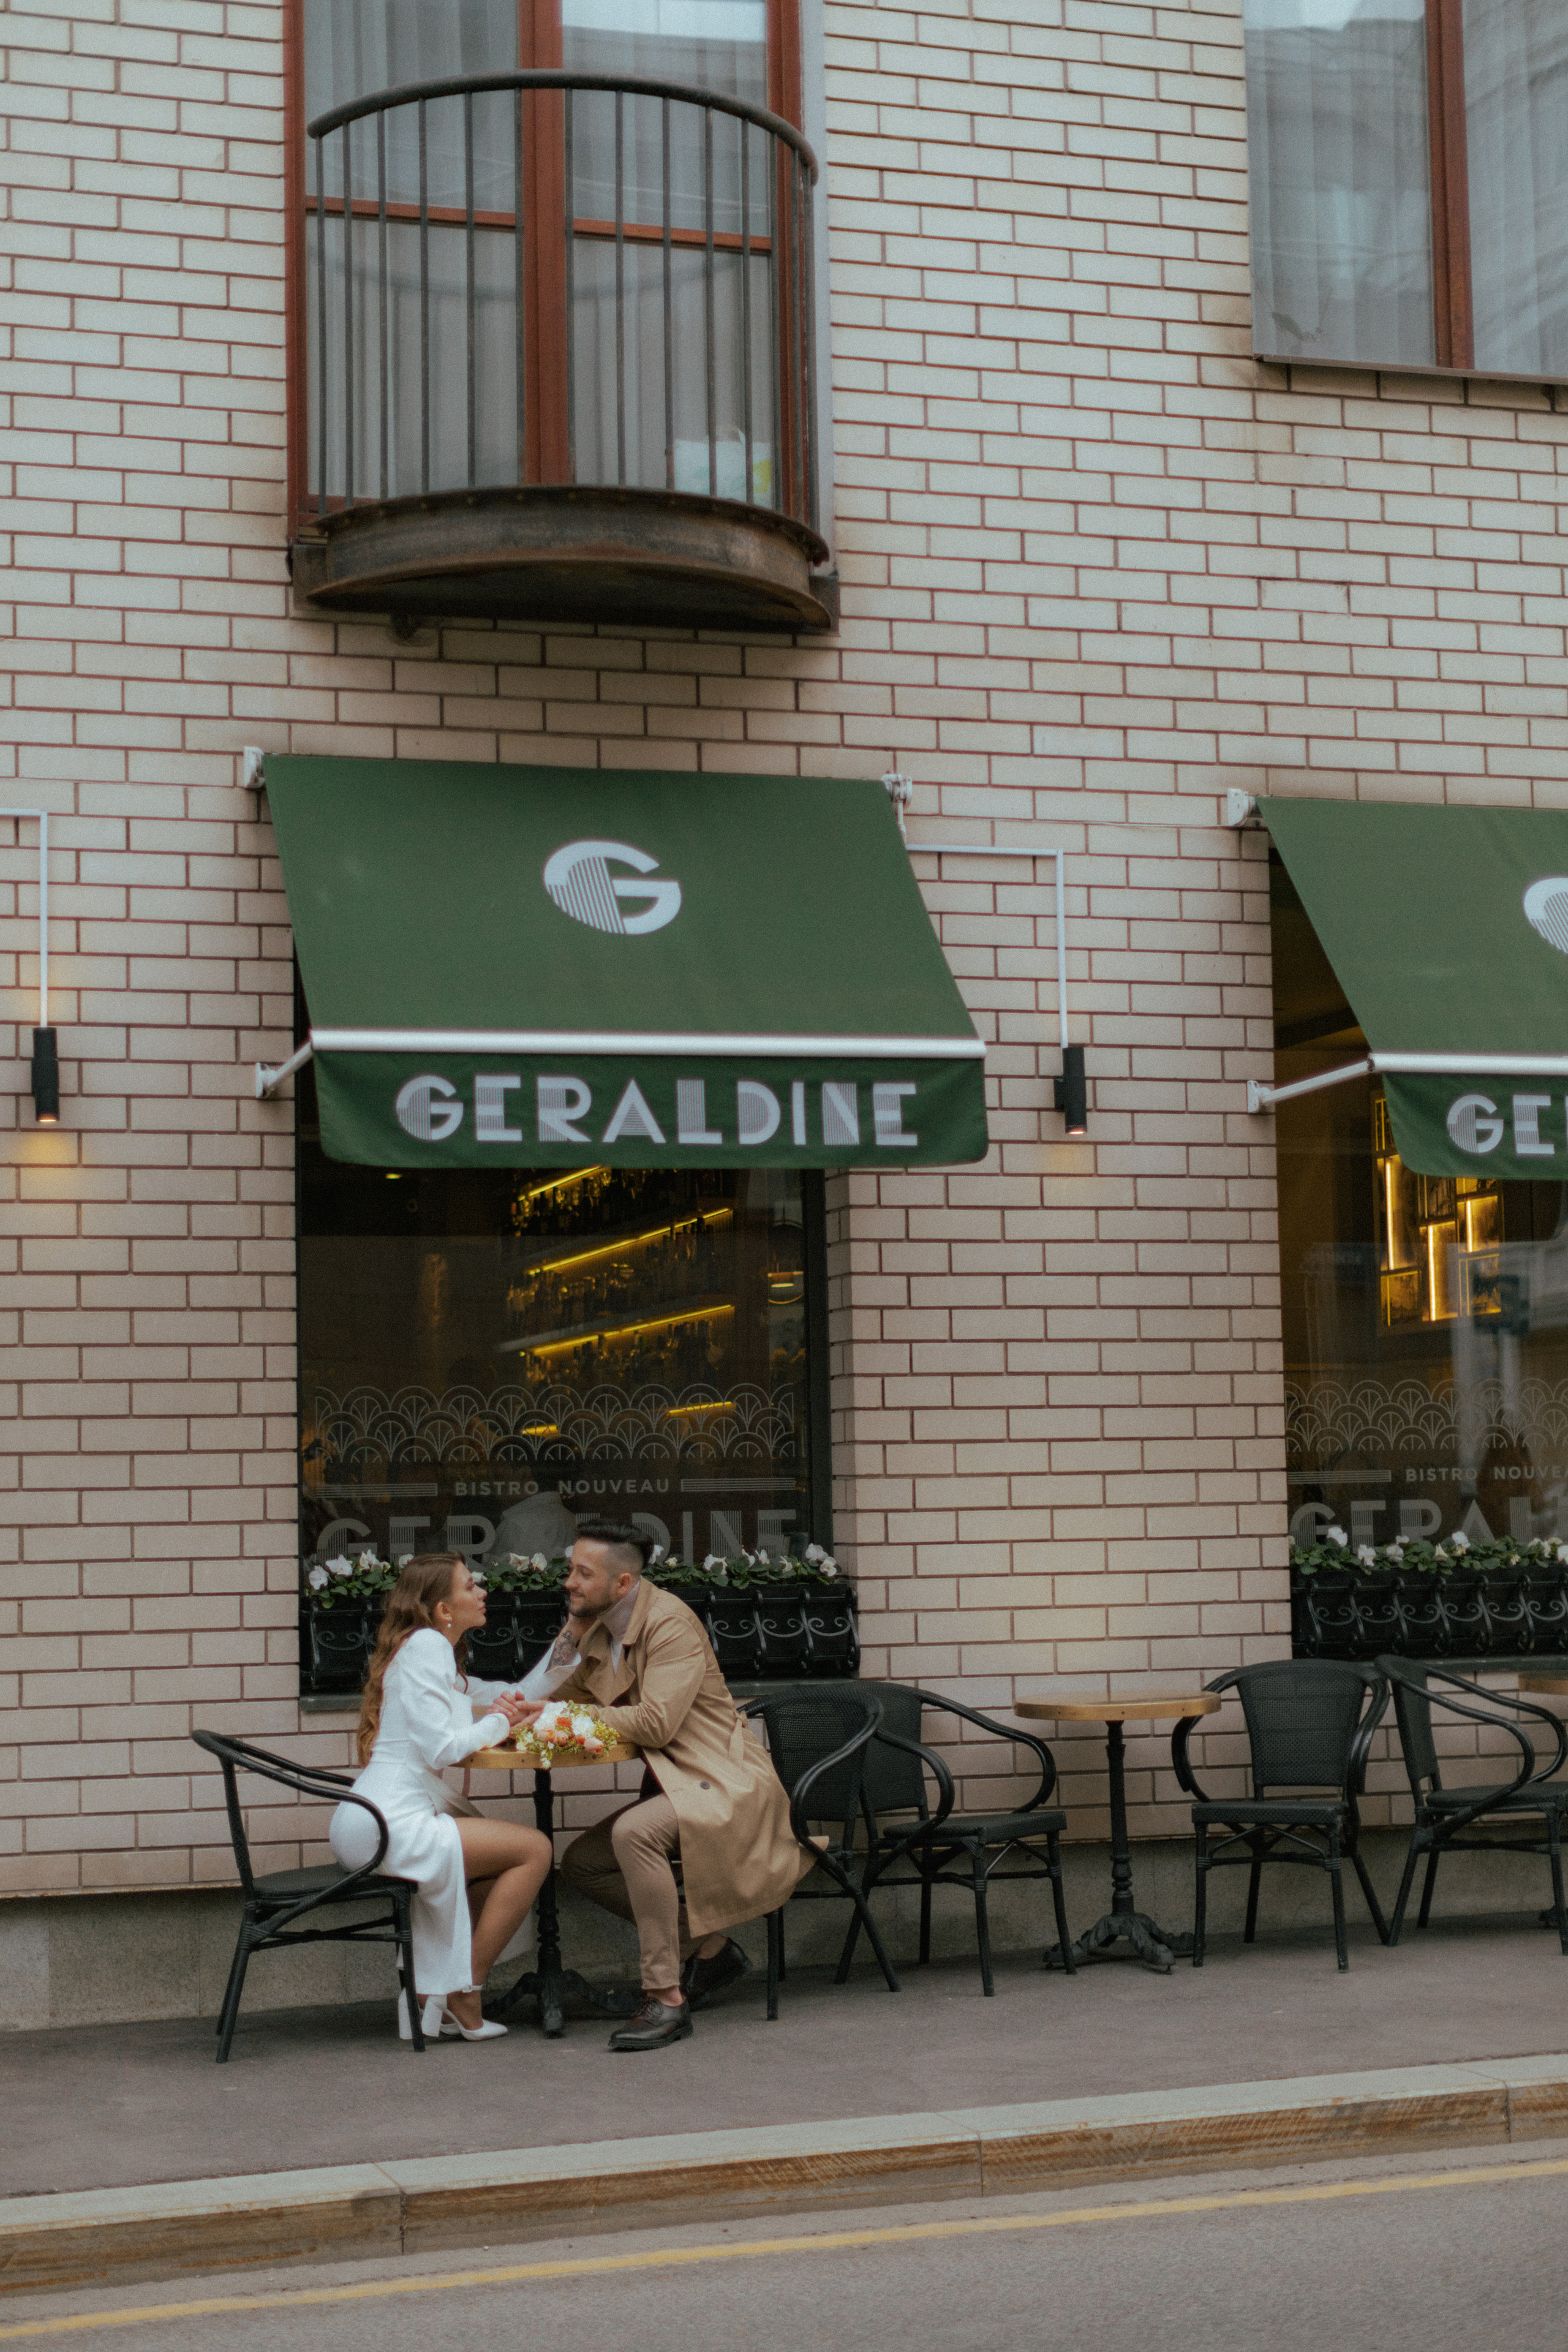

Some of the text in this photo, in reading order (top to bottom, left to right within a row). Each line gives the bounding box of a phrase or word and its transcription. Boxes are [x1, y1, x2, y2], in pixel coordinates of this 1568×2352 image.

[543, 840, 682, 935] G
[395, 1075, 918, 1147] GERALDINE
[1447, 1094, 1568, 1155] GE
[455, 1479, 669, 1496] BISTRO NOUVEAU
[1406, 1468, 1478, 1482] BISTRO
[317, 1509, 796, 1570] GERDINE
[1290, 1494, 1568, 1552] GERAL
